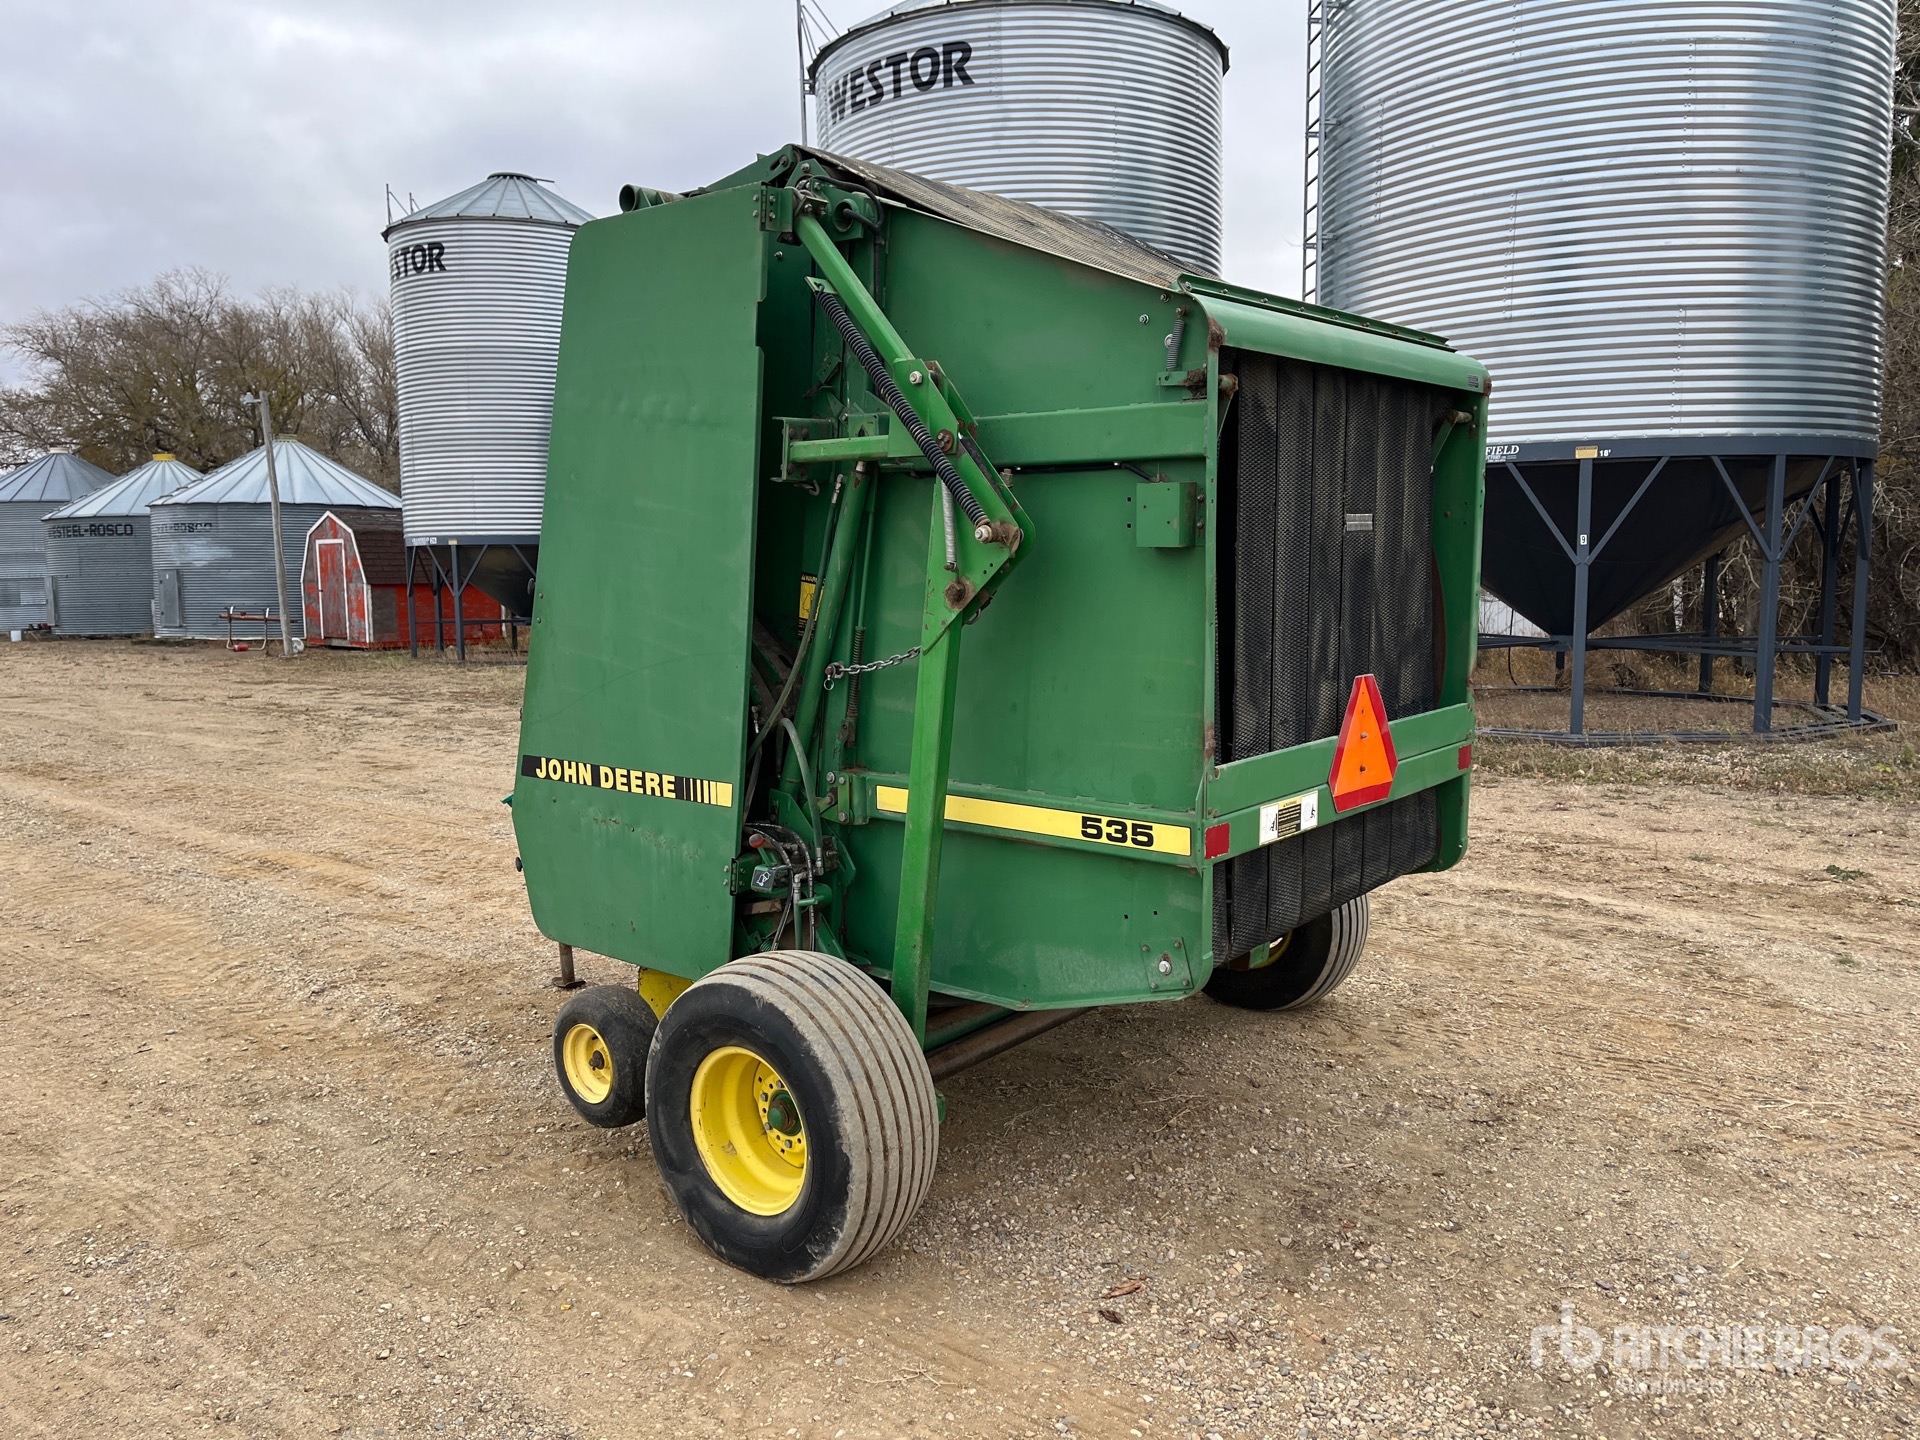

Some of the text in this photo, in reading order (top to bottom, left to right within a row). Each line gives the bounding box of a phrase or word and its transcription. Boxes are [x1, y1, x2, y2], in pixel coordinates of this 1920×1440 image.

[827, 41, 976, 125] WESTOR
[535, 757, 677, 799] JOHN DEERE
[1081, 815, 1154, 848] 535
